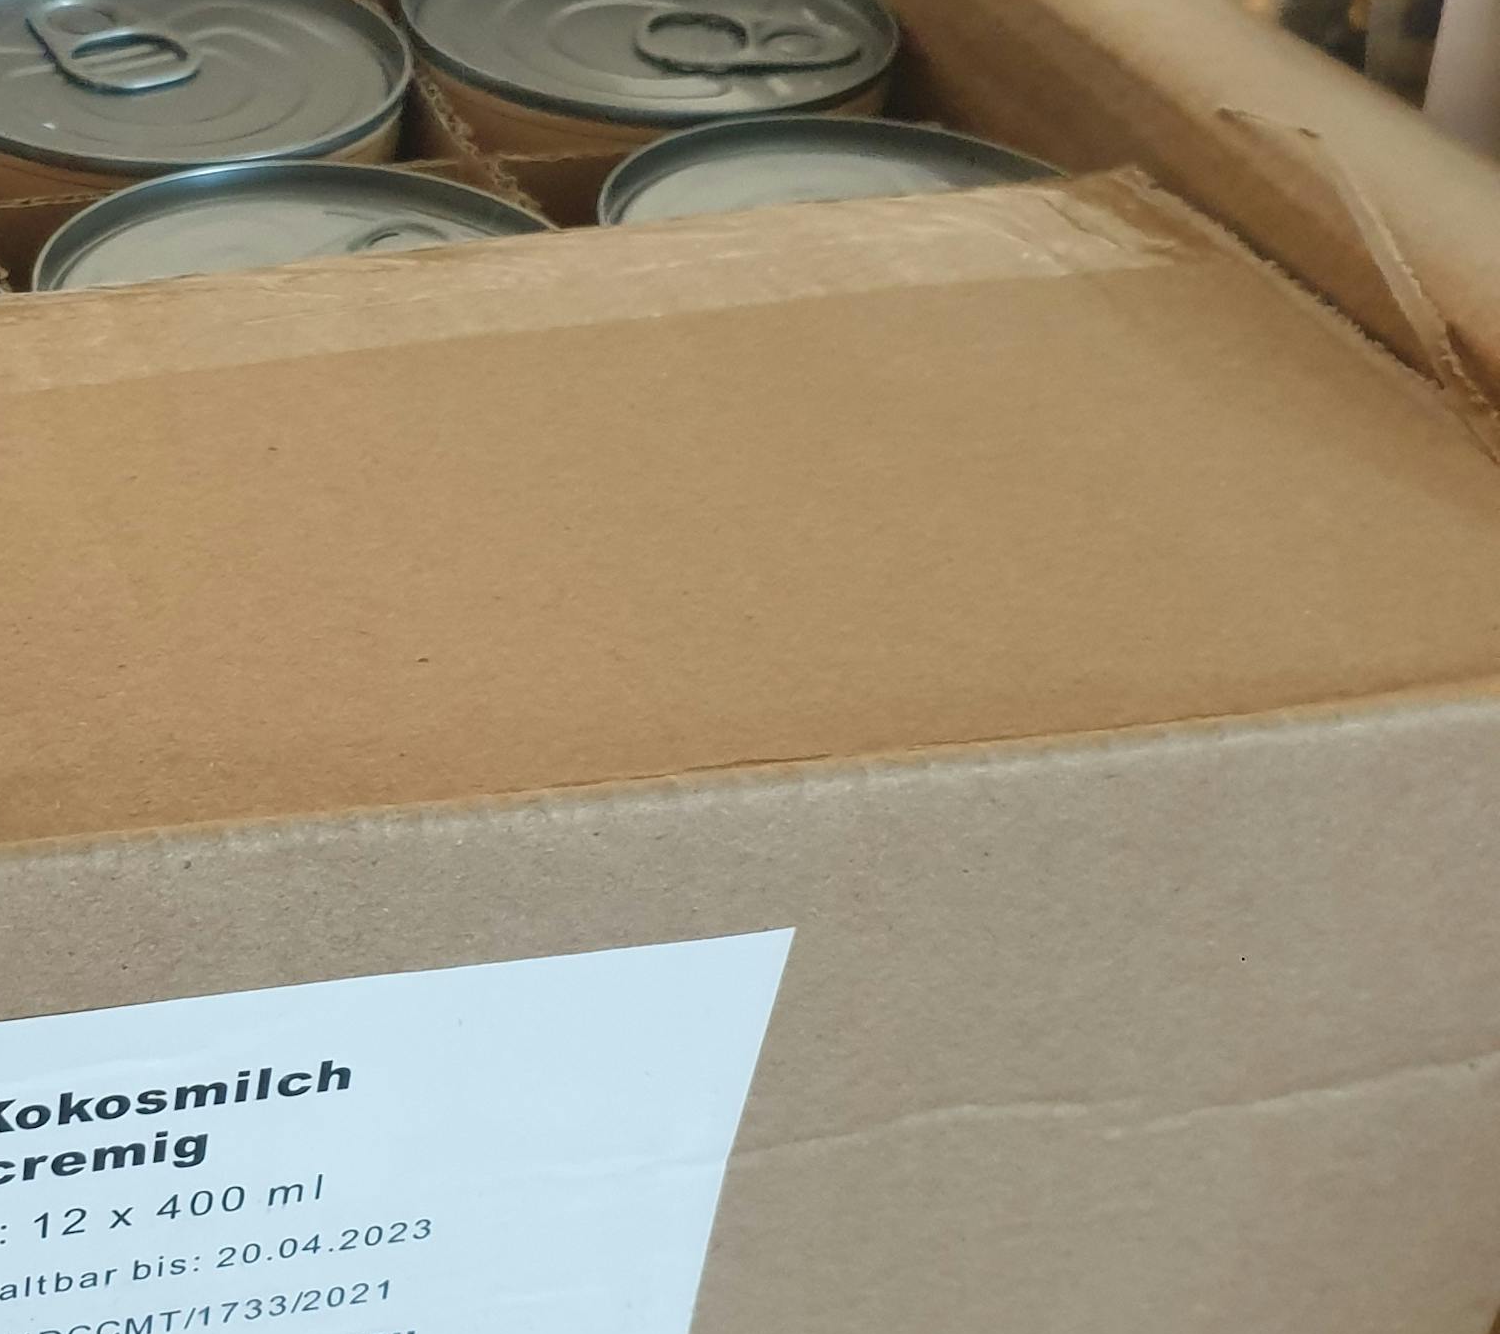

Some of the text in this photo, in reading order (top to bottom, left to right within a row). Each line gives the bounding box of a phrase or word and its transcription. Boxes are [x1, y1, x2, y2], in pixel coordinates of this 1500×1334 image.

[33, 1208, 88, 1241] 12
[109, 1206, 134, 1230] x
[155, 1186, 247, 1222] 400
[267, 1174, 324, 1208] ml
[132, 1251, 202, 1282] bis:
[215, 1218, 434, 1270] 20.04.2023
